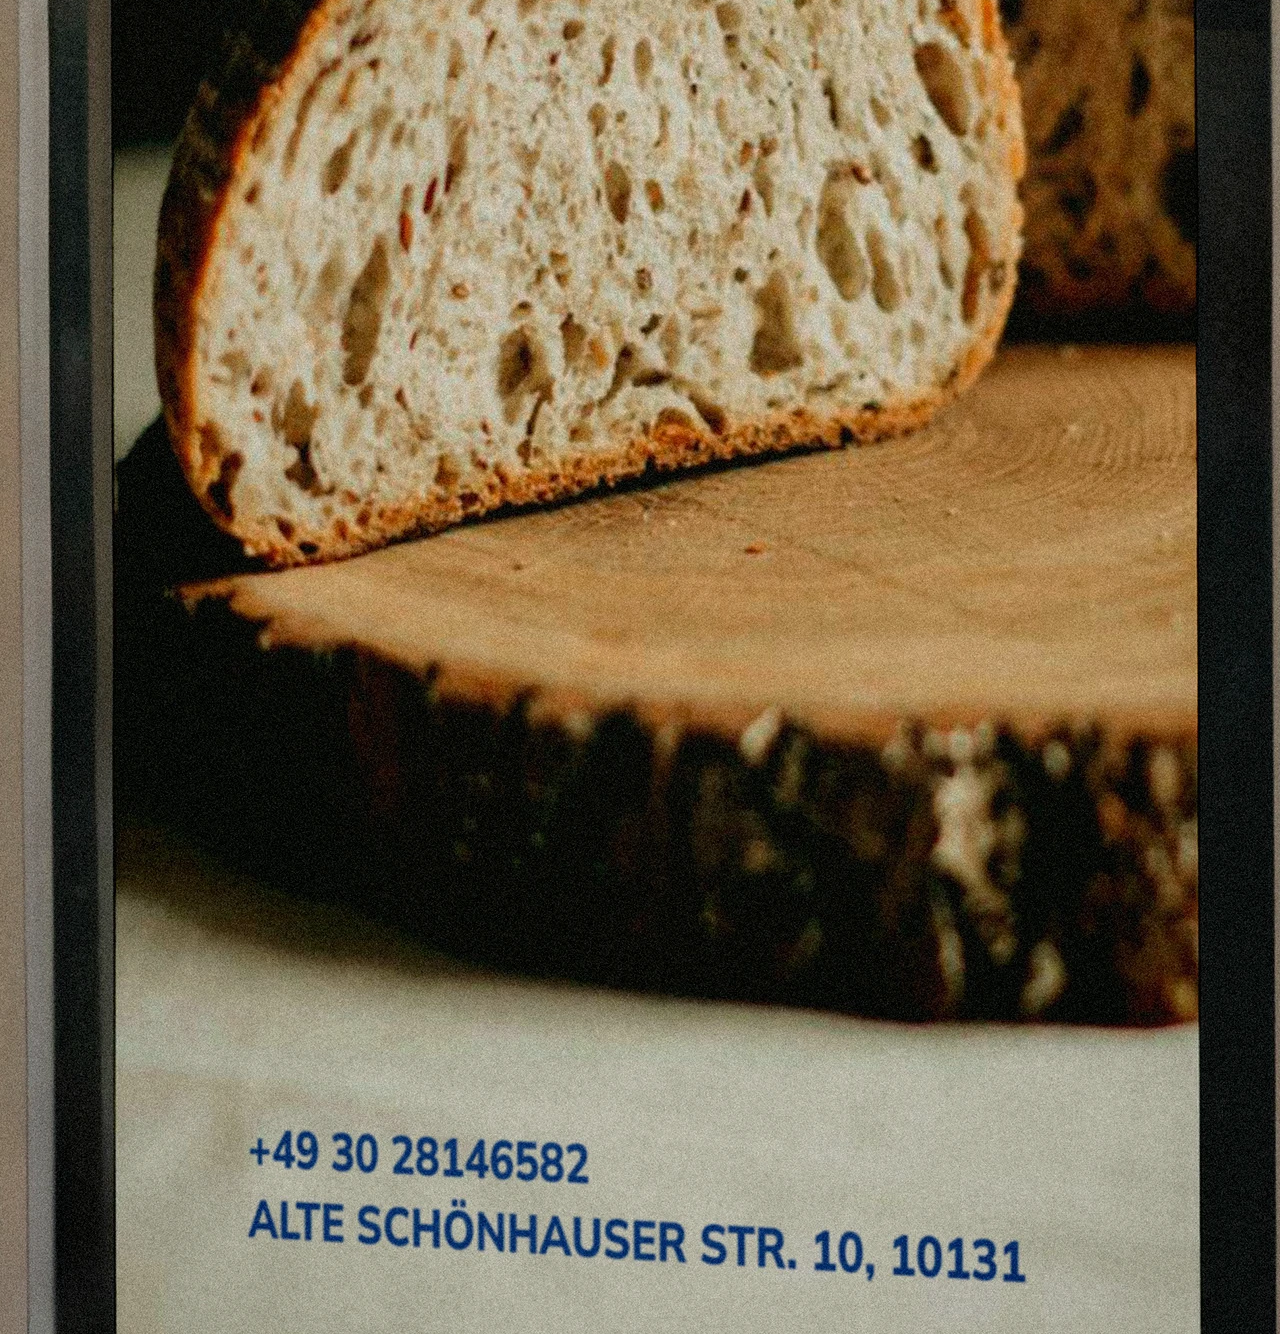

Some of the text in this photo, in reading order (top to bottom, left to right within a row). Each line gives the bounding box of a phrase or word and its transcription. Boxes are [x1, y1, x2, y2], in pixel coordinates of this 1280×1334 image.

[248, 1130, 589, 1184] +49 30 28146582
[248, 1199, 1026, 1283] ALTE SCHÖNHAUSER STR. 10, 10131
